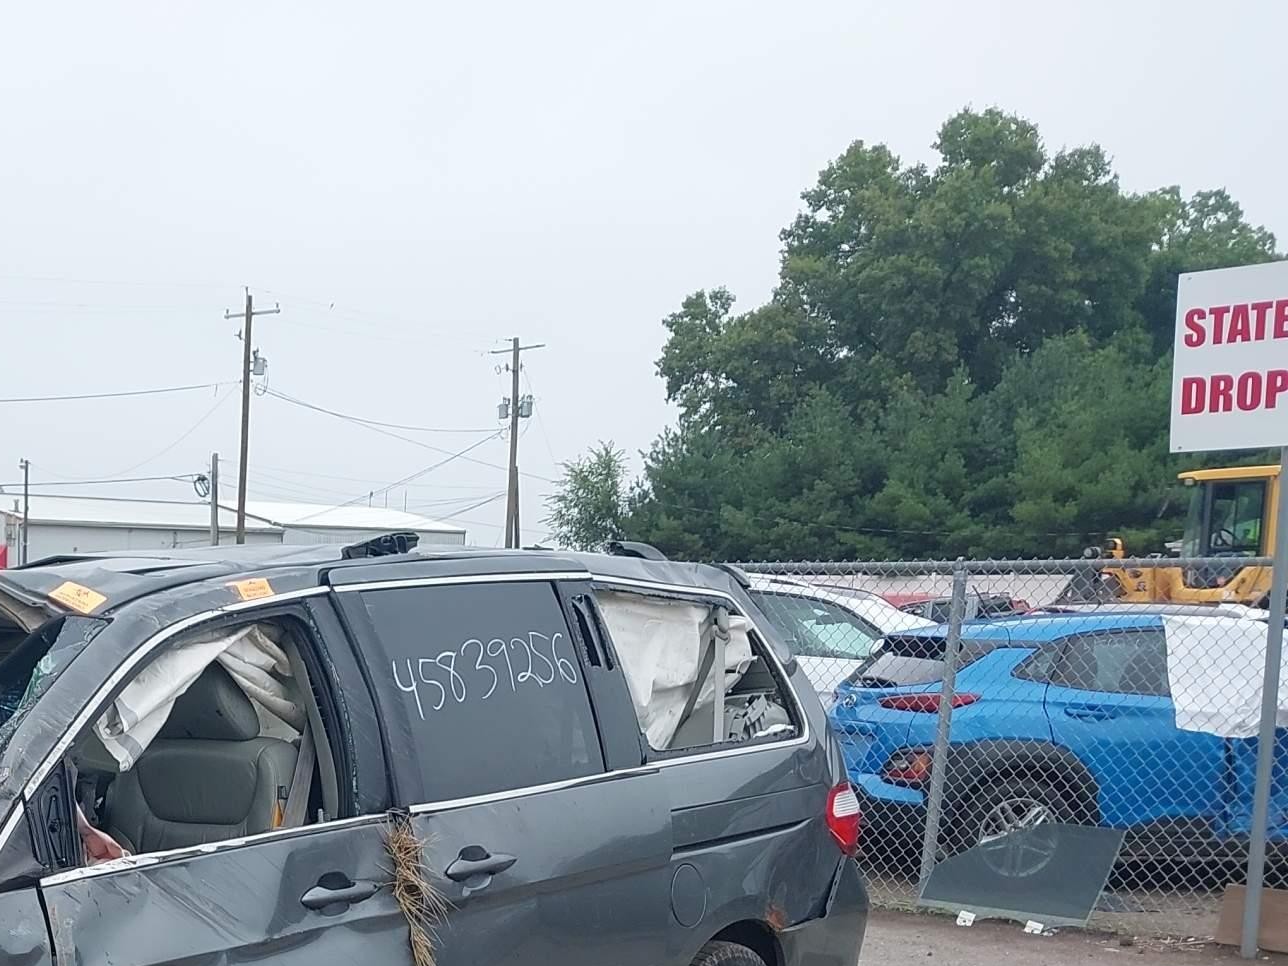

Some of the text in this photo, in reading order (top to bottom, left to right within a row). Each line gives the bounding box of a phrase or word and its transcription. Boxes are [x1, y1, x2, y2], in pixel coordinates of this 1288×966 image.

[1184, 299, 1288, 348] STATE
[1181, 369, 1288, 416] DROP
[392, 631, 577, 720] 45839256
